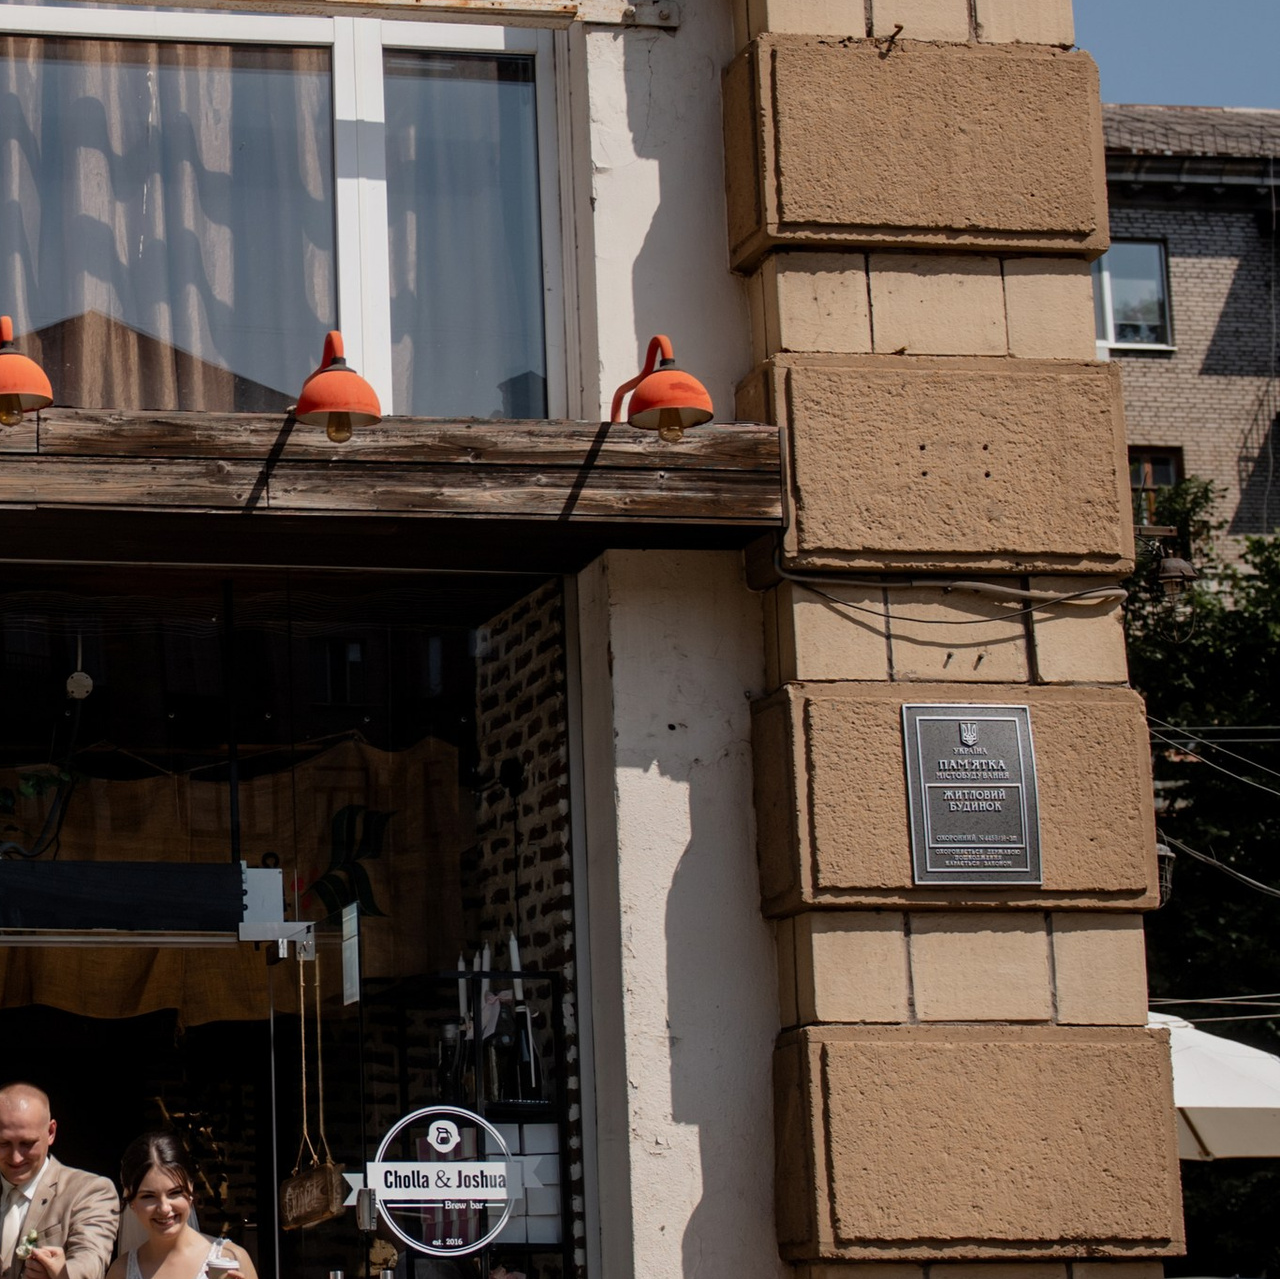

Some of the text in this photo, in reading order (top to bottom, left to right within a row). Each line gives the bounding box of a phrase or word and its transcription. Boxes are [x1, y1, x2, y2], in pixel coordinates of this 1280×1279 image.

[952, 747, 988, 755] УКРАЇНА
[939, 759, 1006, 770] ПАМ'ЯТКА
[936, 771, 1009, 780] МІСТОБУДУВАННЯ
[943, 789, 1006, 801] ЖИТЛОВИЙ
[949, 801, 1002, 812] БУДИНОК
[936, 834, 976, 842] ОХОРОННИЙ
[384, 1169, 506, 1189] Cholla & Joshua
[445, 1201, 484, 1210] Brew bar
[446, 1238, 463, 1246] 2016
